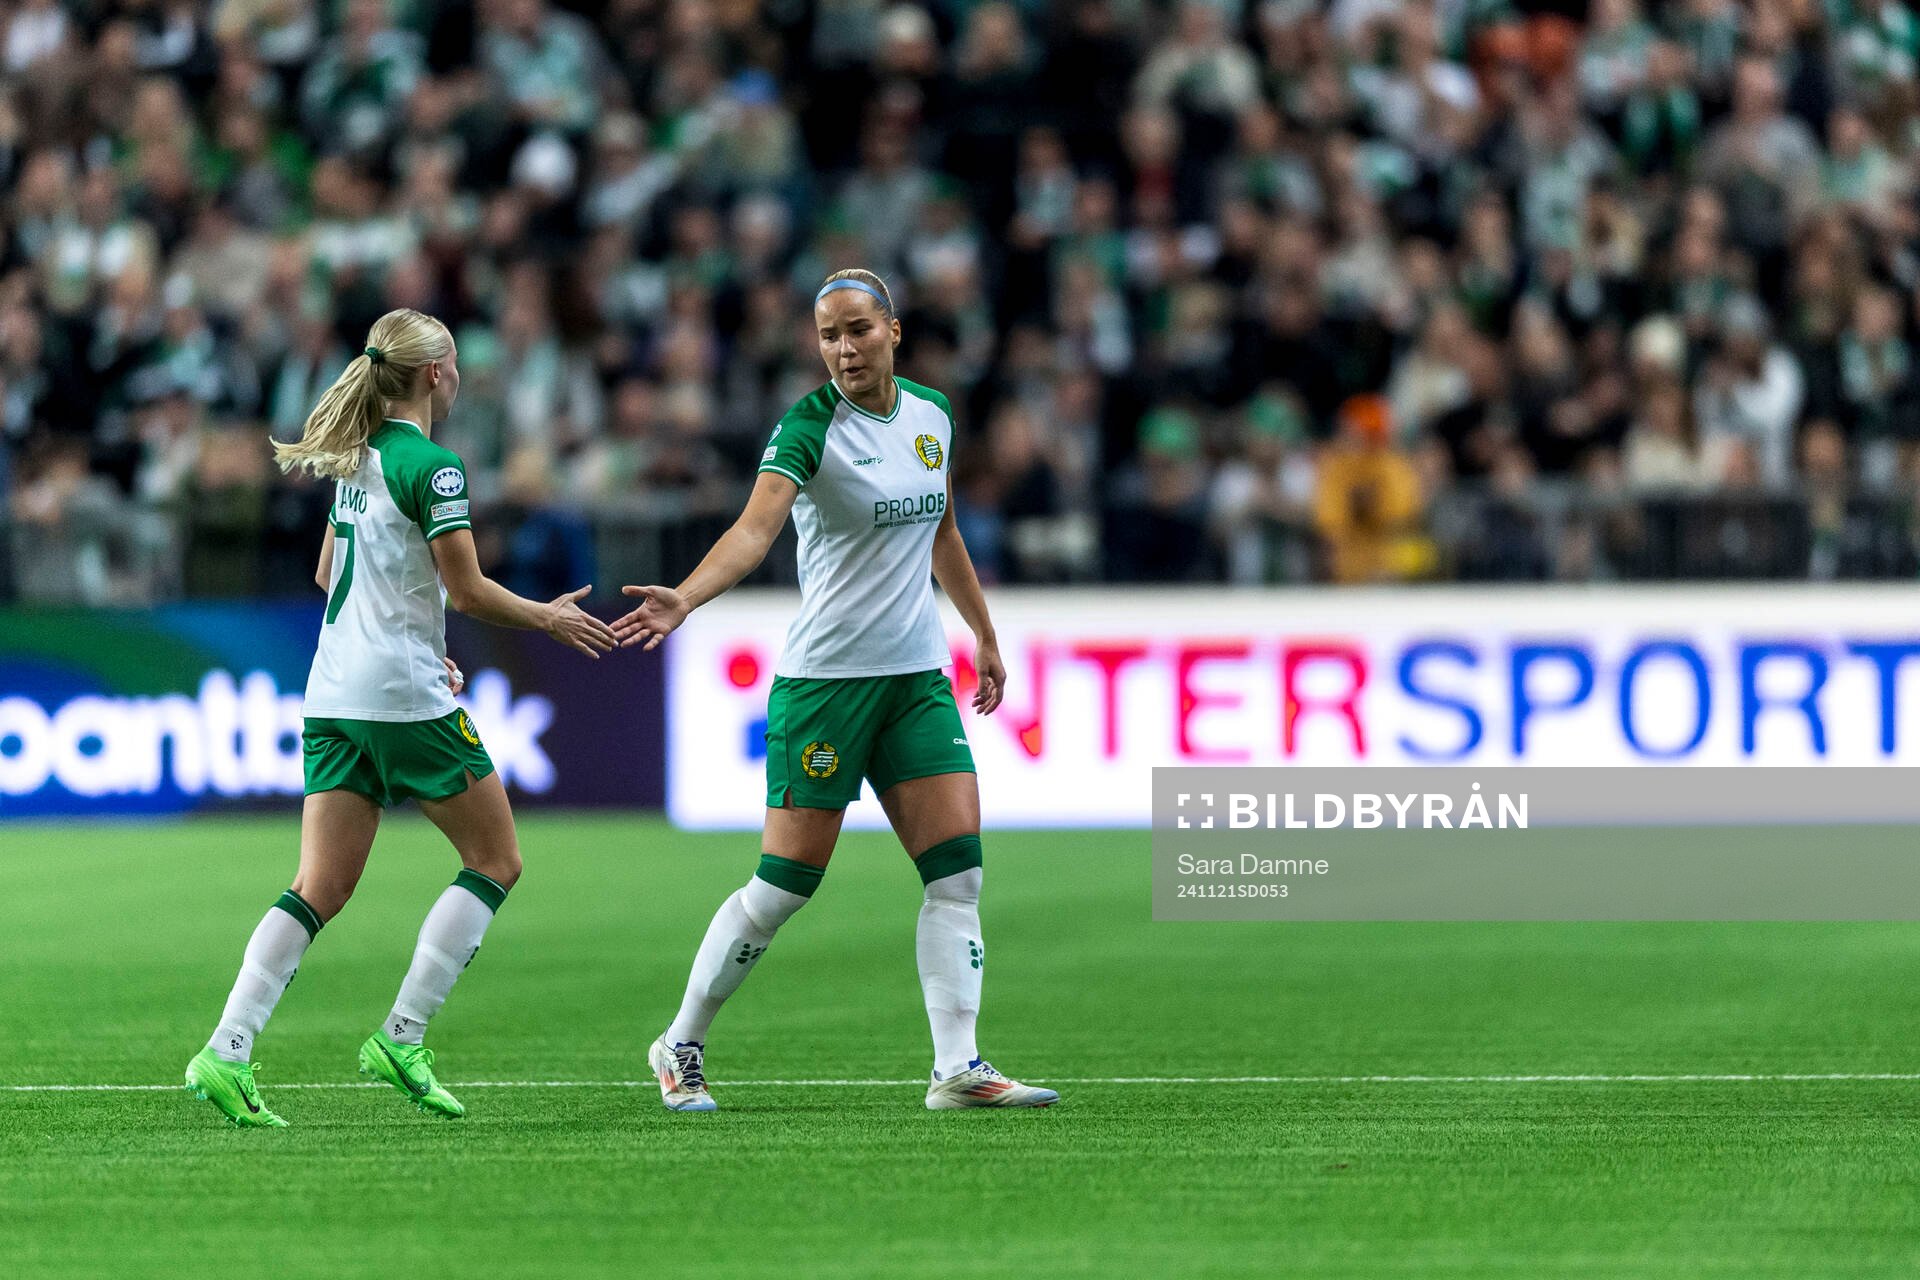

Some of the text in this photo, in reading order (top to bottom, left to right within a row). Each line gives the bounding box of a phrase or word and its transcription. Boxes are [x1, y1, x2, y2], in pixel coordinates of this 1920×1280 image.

[853, 457, 876, 466] CRAFT
[874, 492, 945, 522] PROJOB
[326, 522, 355, 625] 7
[946, 636, 1920, 760] NTERSPORT
